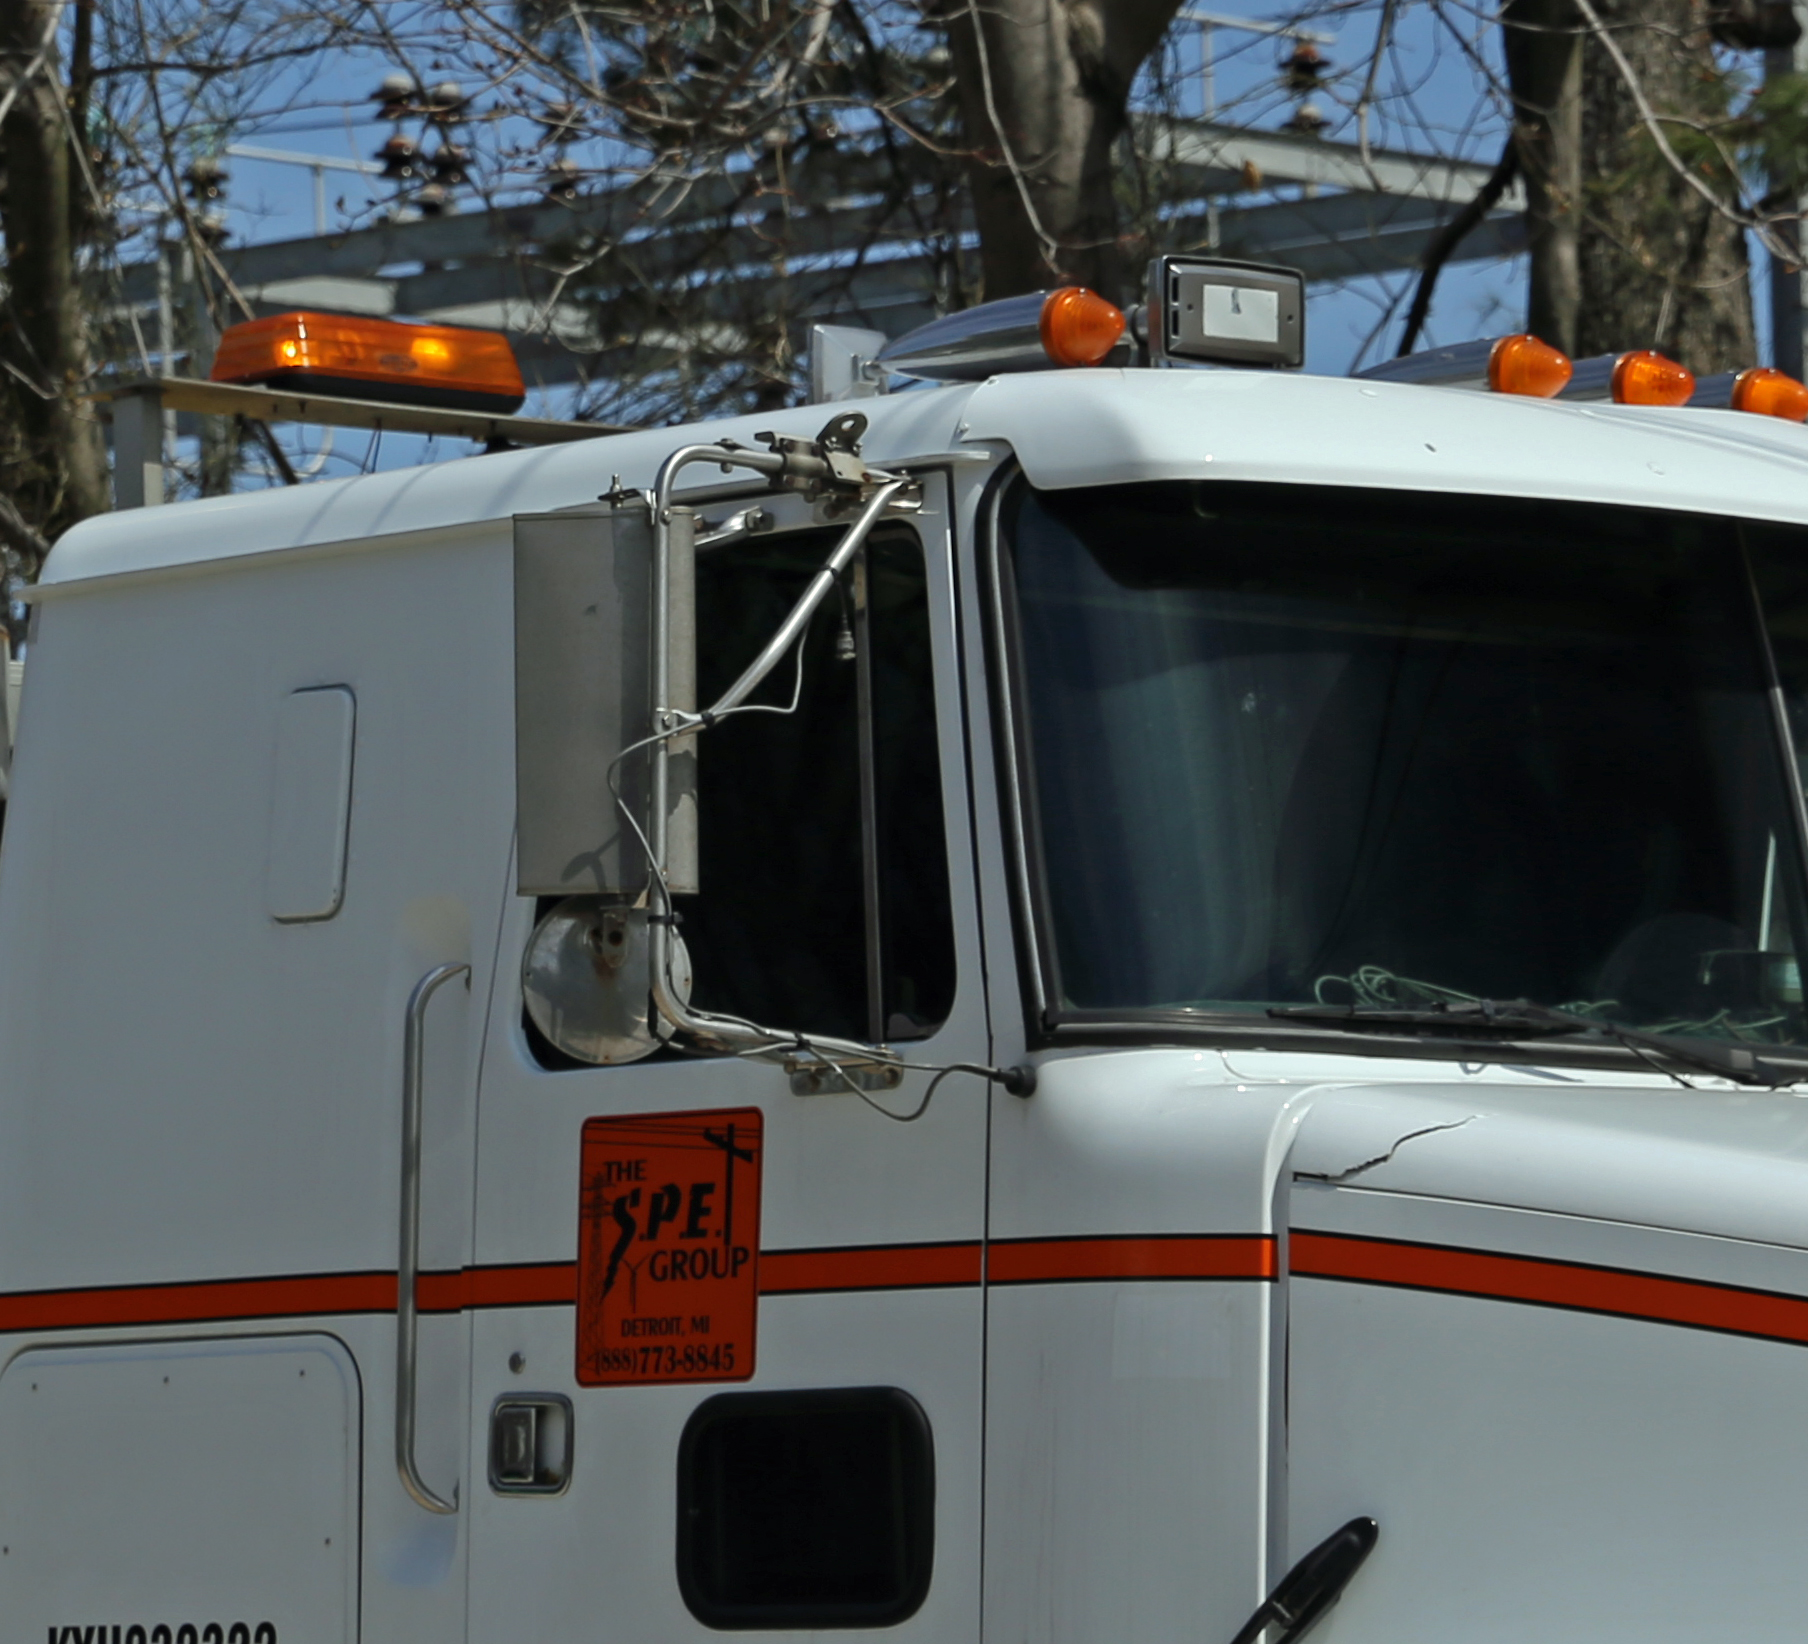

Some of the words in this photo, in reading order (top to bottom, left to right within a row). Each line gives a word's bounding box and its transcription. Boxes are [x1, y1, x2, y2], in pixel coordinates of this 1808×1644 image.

[604, 1160, 647, 1182] THE
[649, 1247, 750, 1282] GROUP
[691, 1315, 710, 1335] MI
